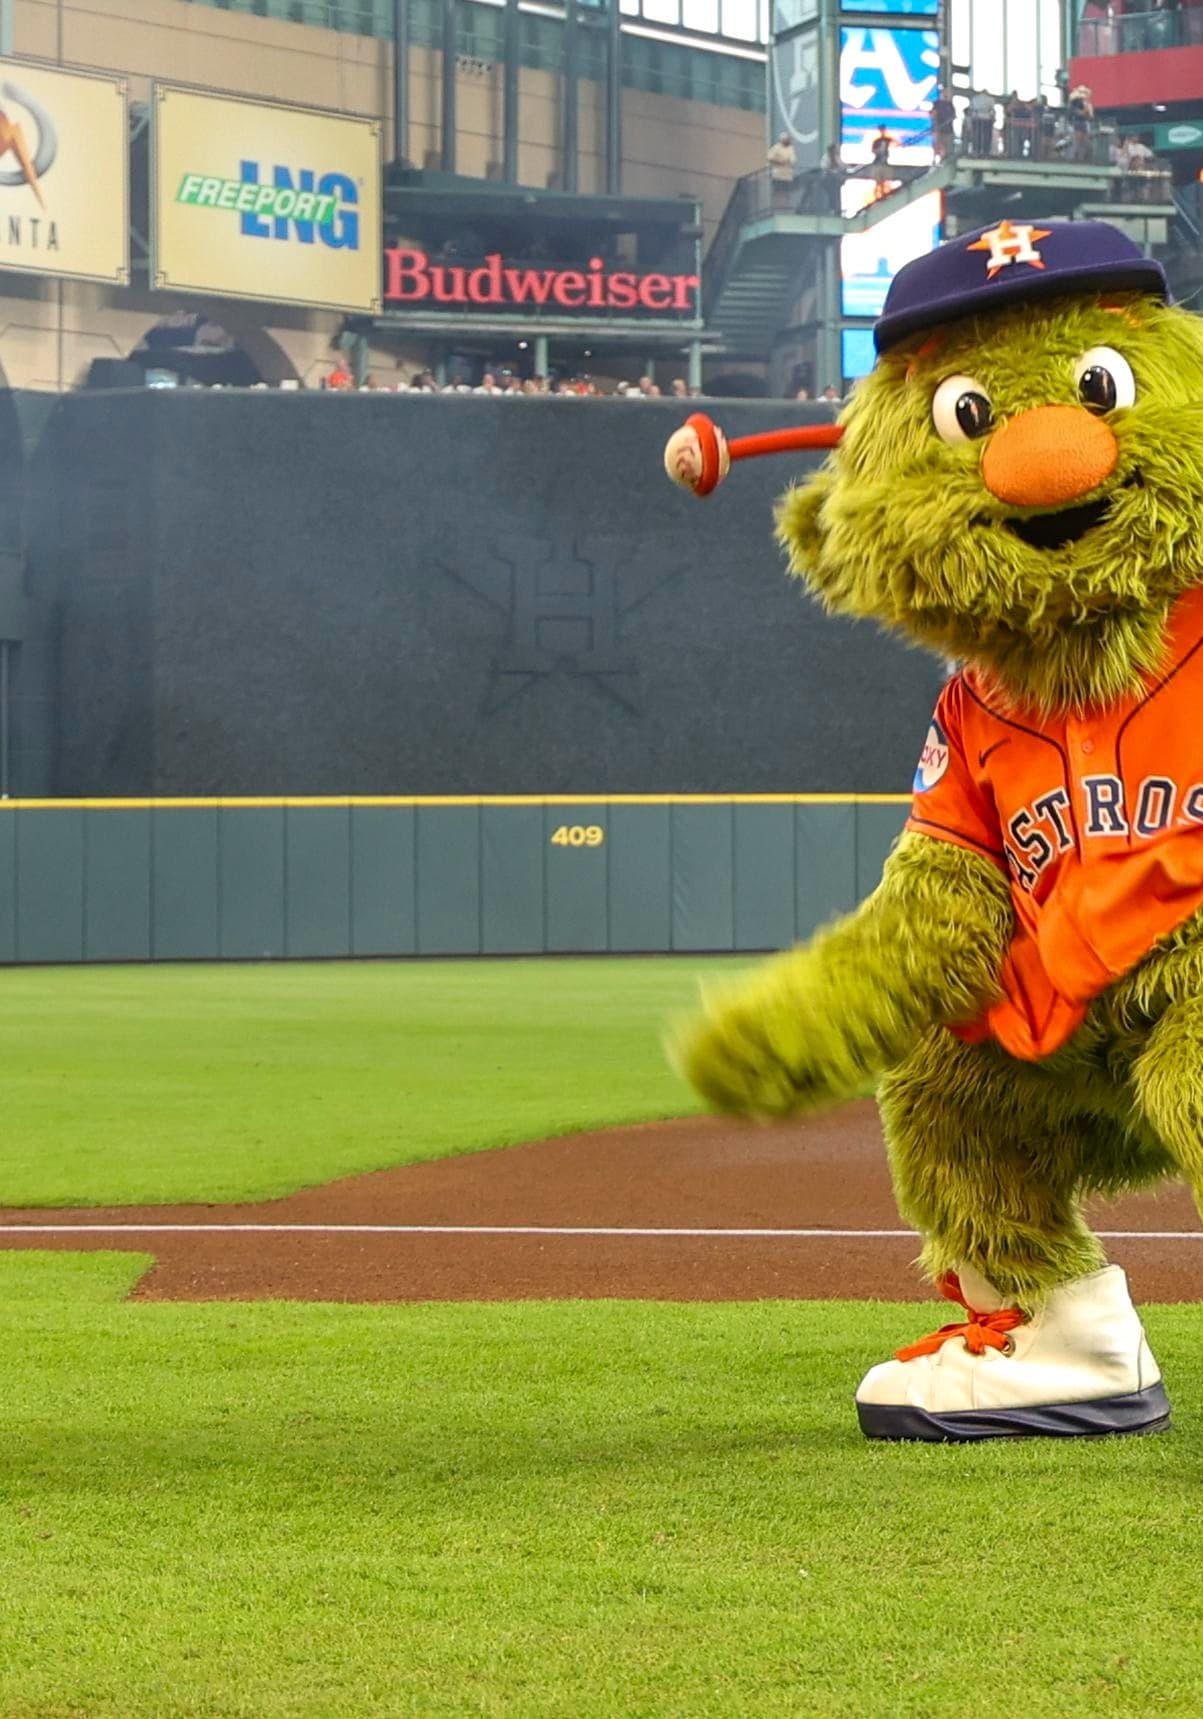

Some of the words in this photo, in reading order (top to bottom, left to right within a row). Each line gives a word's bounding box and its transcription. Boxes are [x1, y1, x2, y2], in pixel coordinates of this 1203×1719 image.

[180, 175, 335, 222] FREEPORT
[239, 160, 360, 251] LNG
[384, 248, 701, 309] Budweiser
[551, 825, 604, 847] 409
